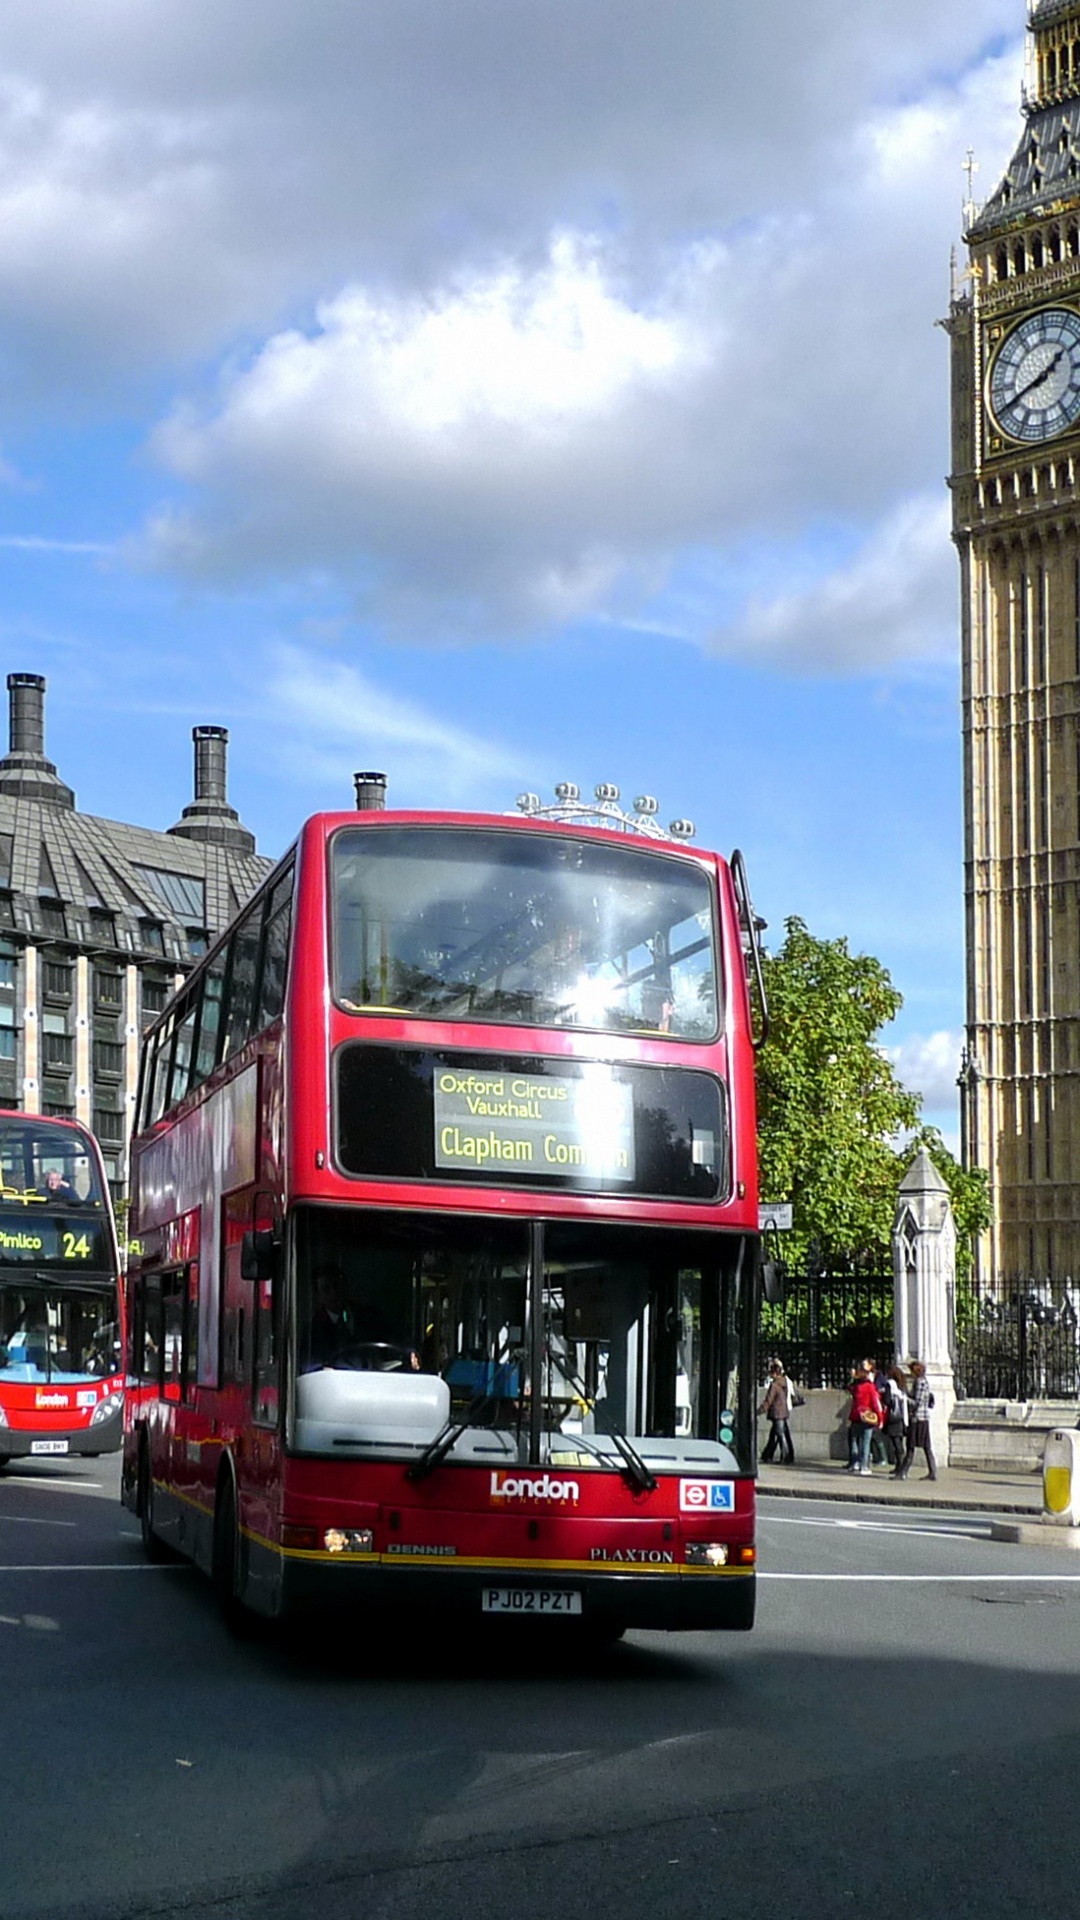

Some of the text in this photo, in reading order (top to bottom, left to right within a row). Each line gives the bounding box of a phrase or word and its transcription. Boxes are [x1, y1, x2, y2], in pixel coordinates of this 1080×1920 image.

[439, 1074, 567, 1100] Oxford Circus
[466, 1096, 542, 1118] Vauxhall
[441, 1127, 533, 1164] Clapham
[62, 1232, 91, 1258] 24
[490, 1471, 579, 1500] London
[387, 1544, 456, 1556] DENNIS
[590, 1547, 674, 1564] PLAXTON
[488, 1591, 574, 1610] PJ02 PZT
